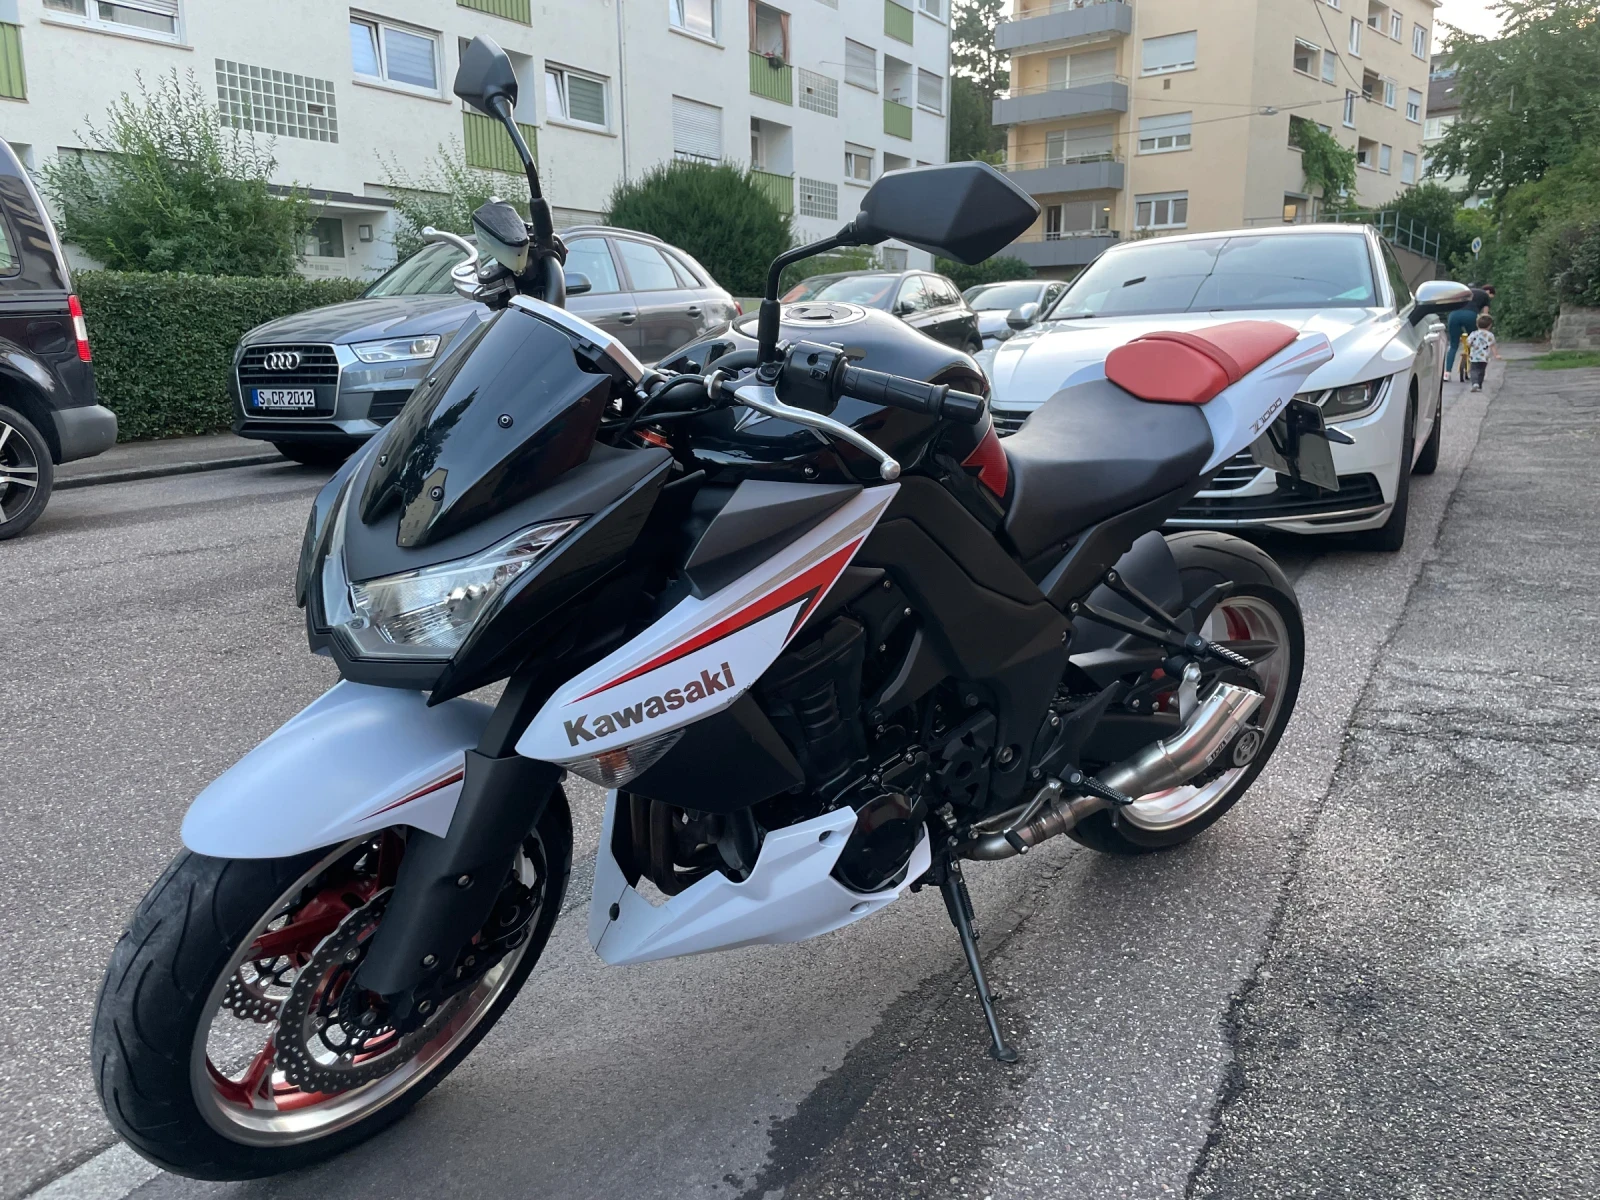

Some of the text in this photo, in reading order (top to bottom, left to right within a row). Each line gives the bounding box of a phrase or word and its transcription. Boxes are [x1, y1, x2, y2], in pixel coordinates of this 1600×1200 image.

[259, 391, 266, 405] S
[1249, 397, 1283, 434] Z1000
[563, 661, 736, 747] Kawasaki
